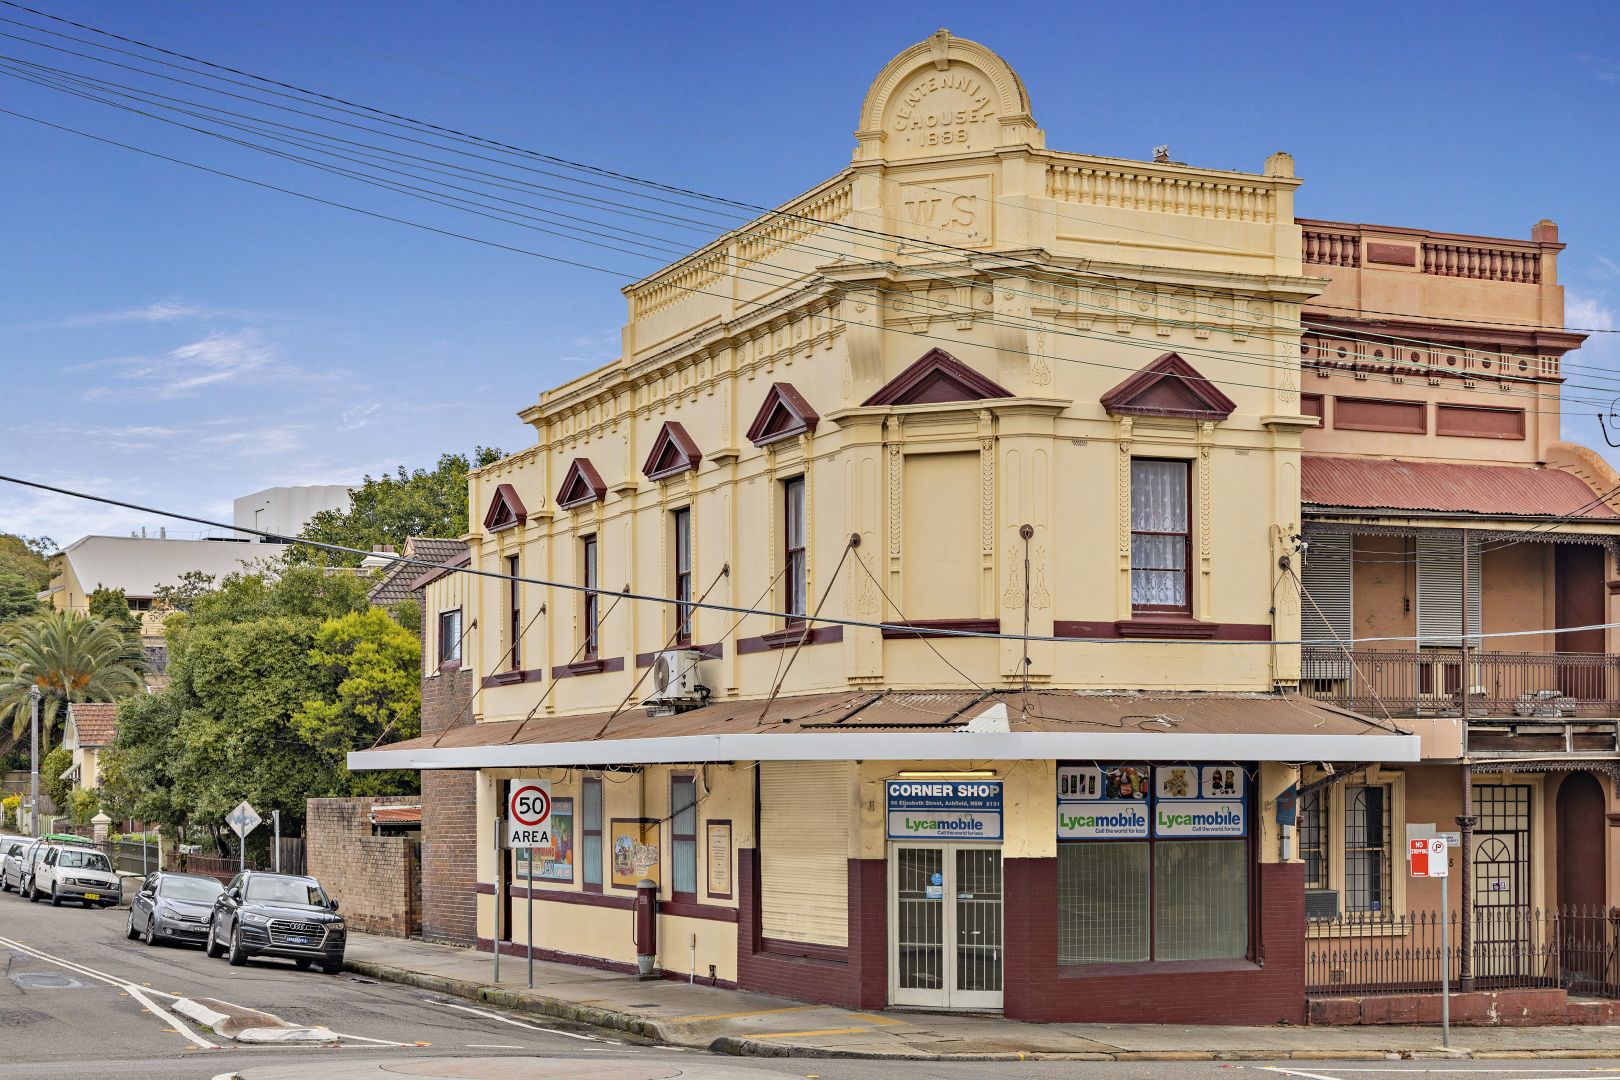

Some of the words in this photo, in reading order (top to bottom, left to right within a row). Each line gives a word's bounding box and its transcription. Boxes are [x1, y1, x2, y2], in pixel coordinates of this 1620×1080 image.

[910, 109, 979, 130] HOUSE
[920, 130, 968, 147] 1888
[889, 785, 953, 797] CORNER
[957, 785, 1000, 797] SHOP
[519, 797, 544, 815] 50
[905, 818, 984, 832] Lycamobile
[1059, 812, 1146, 830] Lycamobile
[1158, 811, 1241, 829] Lycamobile
[512, 831, 549, 843] AREA
